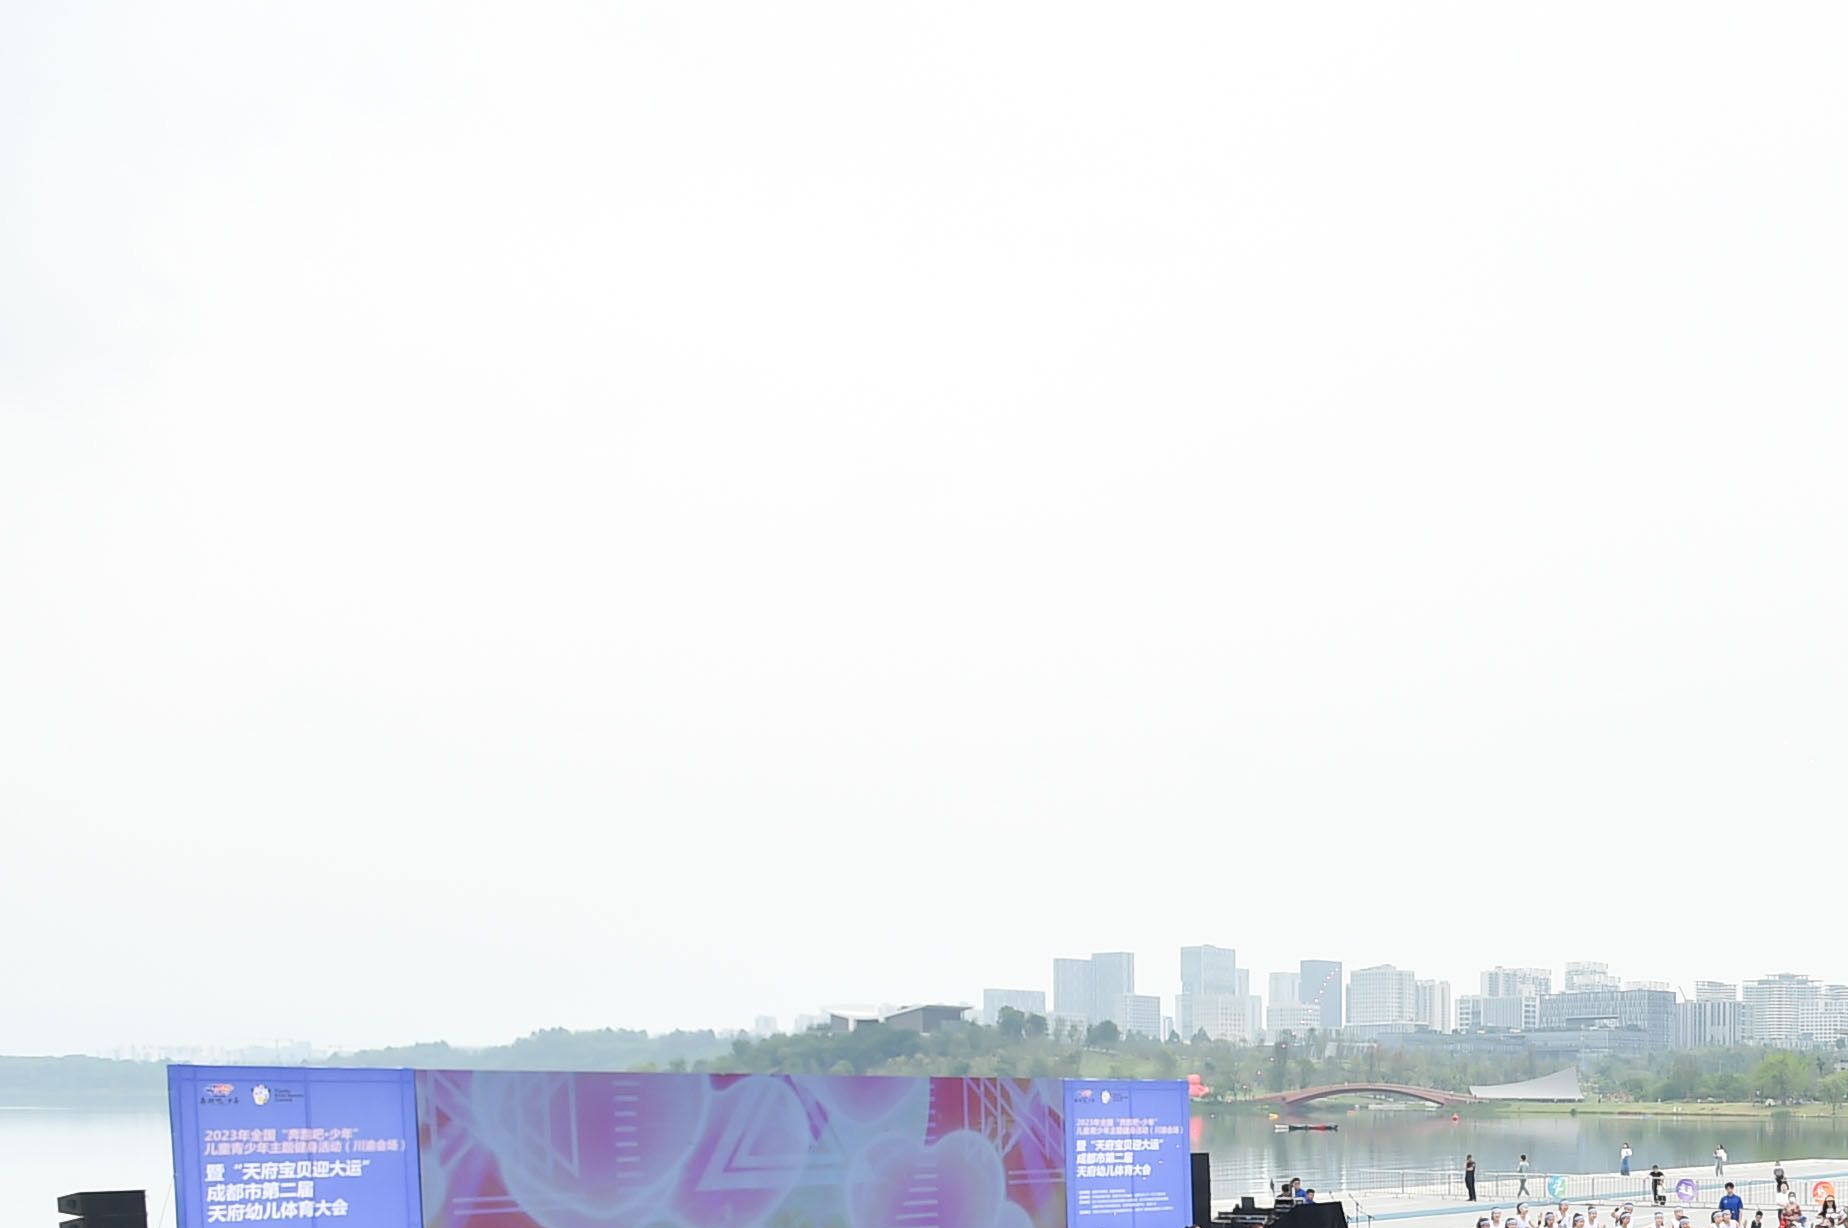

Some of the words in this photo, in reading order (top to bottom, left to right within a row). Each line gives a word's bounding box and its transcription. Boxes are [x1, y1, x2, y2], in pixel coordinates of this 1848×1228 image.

[206, 1180, 314, 1202] 成都市第二届
[207, 1198, 348, 1223] 天府幼儿体育大会
